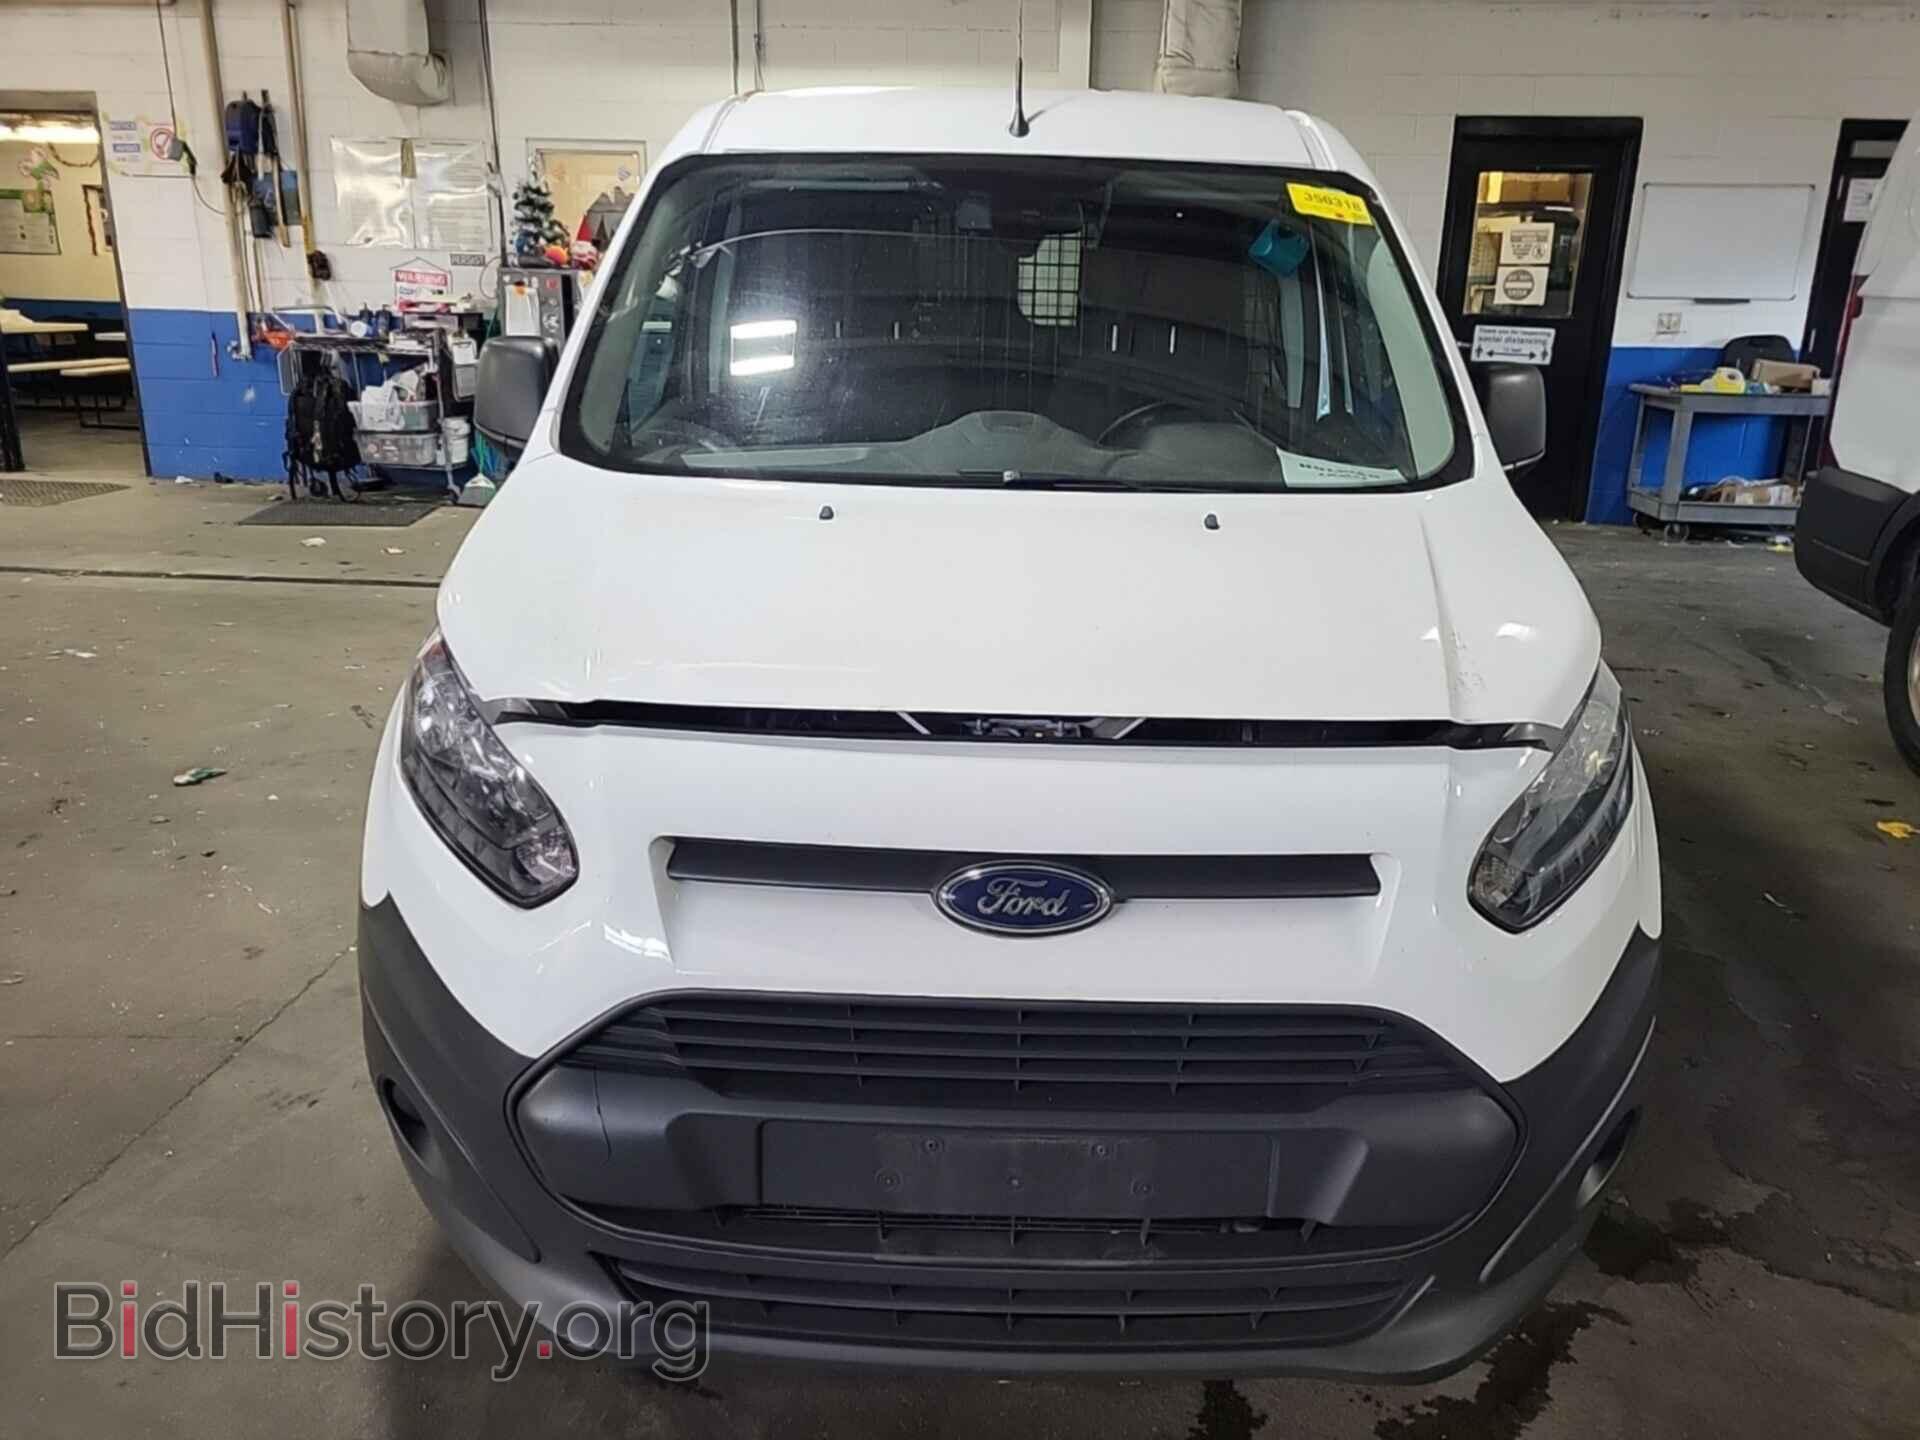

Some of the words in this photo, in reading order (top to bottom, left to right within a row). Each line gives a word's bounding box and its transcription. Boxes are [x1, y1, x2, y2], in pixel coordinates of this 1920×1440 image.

[451, 255, 484, 265] PERSIST
[399, 272, 445, 285] WARNING
[1504, 336, 1548, 347] distancing
[977, 878, 1070, 916] Ford
